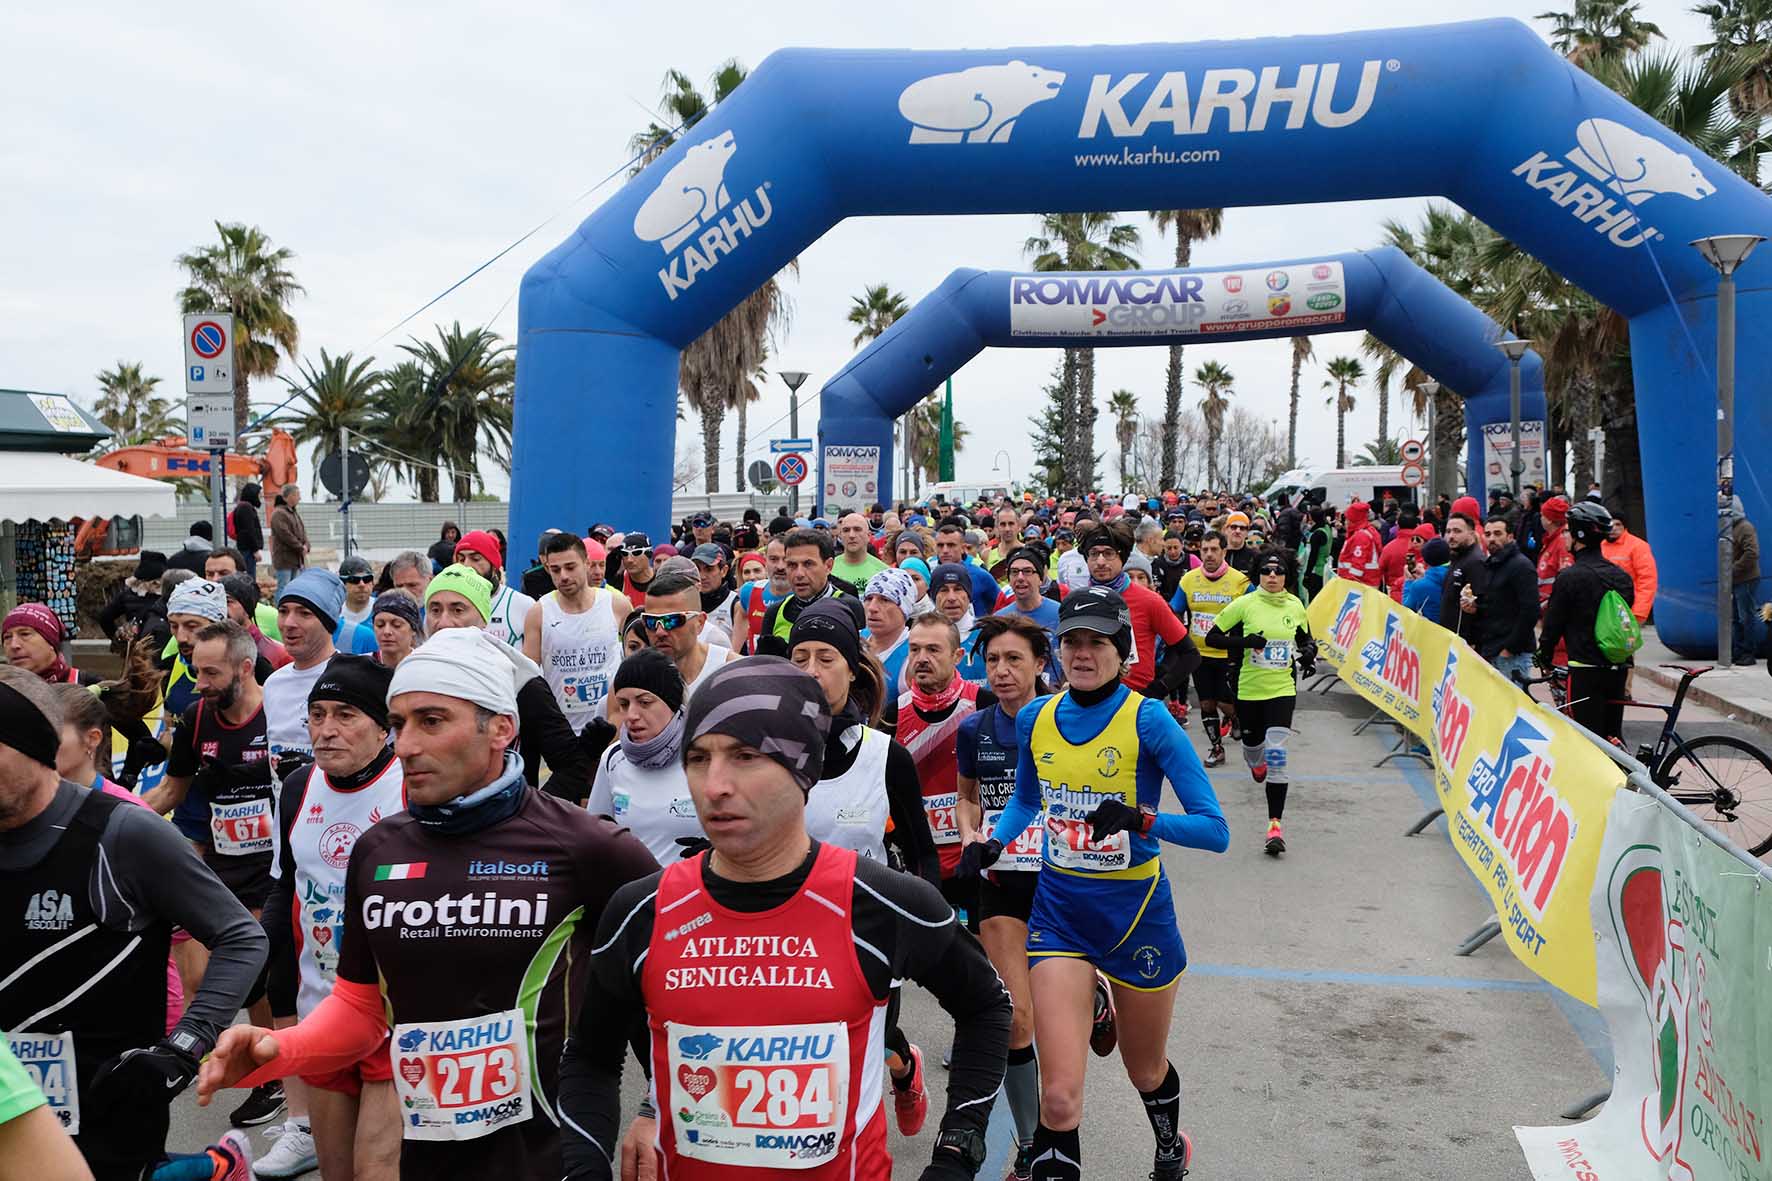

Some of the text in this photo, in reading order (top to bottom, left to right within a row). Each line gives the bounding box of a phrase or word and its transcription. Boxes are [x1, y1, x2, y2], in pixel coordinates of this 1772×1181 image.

[1078, 60, 1382, 138] KARHU
[1074, 146, 1220, 167] www.karhu.com
[1511, 151, 1659, 248] KARHU
[658, 185, 773, 300] KARHU
[1014, 276, 1205, 305] ROMACAR
[1108, 302, 1206, 327] GROUP
[1205, 313, 1343, 332] www.grupporomacar.it
[826, 448, 877, 457] ROMACAR
[579, 654, 586, 666] &
[1270, 647, 1286, 660] 82
[577, 672, 607, 685] KARHU
[585, 683, 604, 700] 57
[1472, 762, 1497, 796] PRO
[224, 803, 264, 818] KARHU
[935, 810, 958, 829] 21
[234, 818, 259, 840] 67
[1015, 828, 1042, 853] 94
[1074, 823, 1121, 850] 14
[468, 860, 550, 875] italsoft
[1016, 856, 1042, 865] ROMAC
[1083, 853, 1125, 861] ROMACAR
[24, 889, 74, 920] ASA
[363, 892, 549, 930] Grottini
[400, 926, 544, 939] Retail Environments
[1508, 903, 1546, 956] SPORT
[679, 935, 819, 960] ATLETICA
[664, 965, 835, 990] SENIGALLIA
[429, 1019, 513, 1052] KARHU
[725, 1033, 835, 1062] KARHU
[10, 1039, 64, 1059] ARHU
[437, 1048, 517, 1105] 273
[734, 1067, 833, 1127] 284
[455, 1097, 522, 1124] ROMACAR
[755, 1131, 836, 1149] ROMACAR
